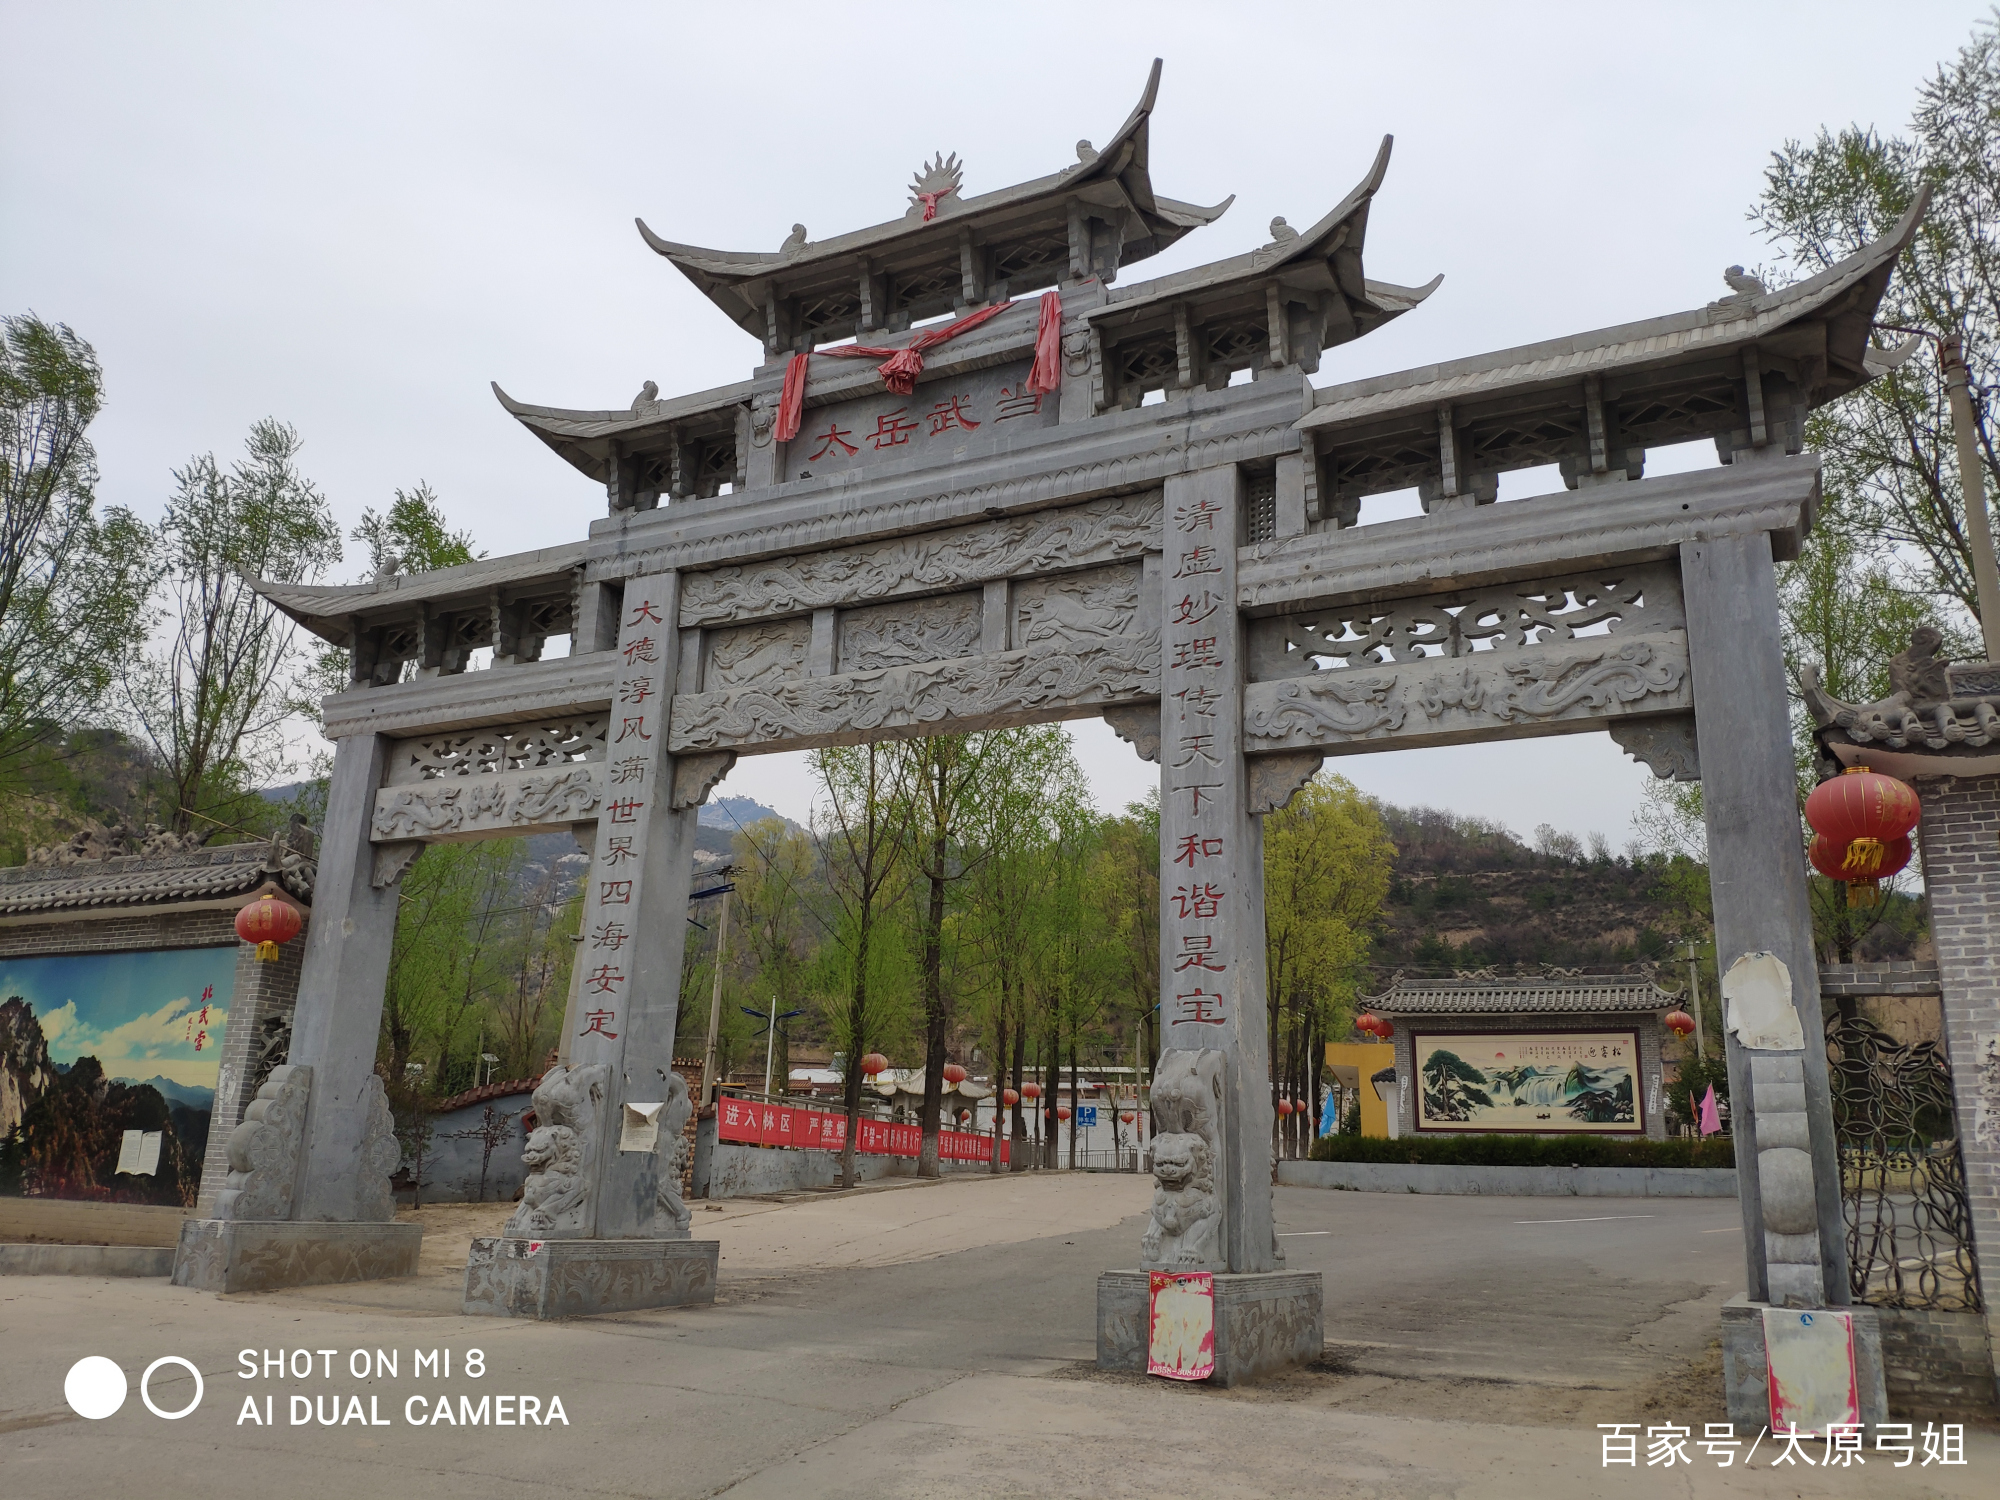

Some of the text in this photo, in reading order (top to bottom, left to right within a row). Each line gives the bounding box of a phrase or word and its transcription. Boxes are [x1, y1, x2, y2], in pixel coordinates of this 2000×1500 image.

[808, 381, 1042, 461] 太岳武当
[1170, 500, 1226, 1027] 清虚妙理传天下和谐是宝
[579, 600, 663, 1040] 大德淳风满世界四海安定
[725, 1105, 857, 1137] 进入林区 严禁烟
[862, 1126, 921, 1151] 严禁一切野外用火行
[1084, 1107, 1092, 1117] P
